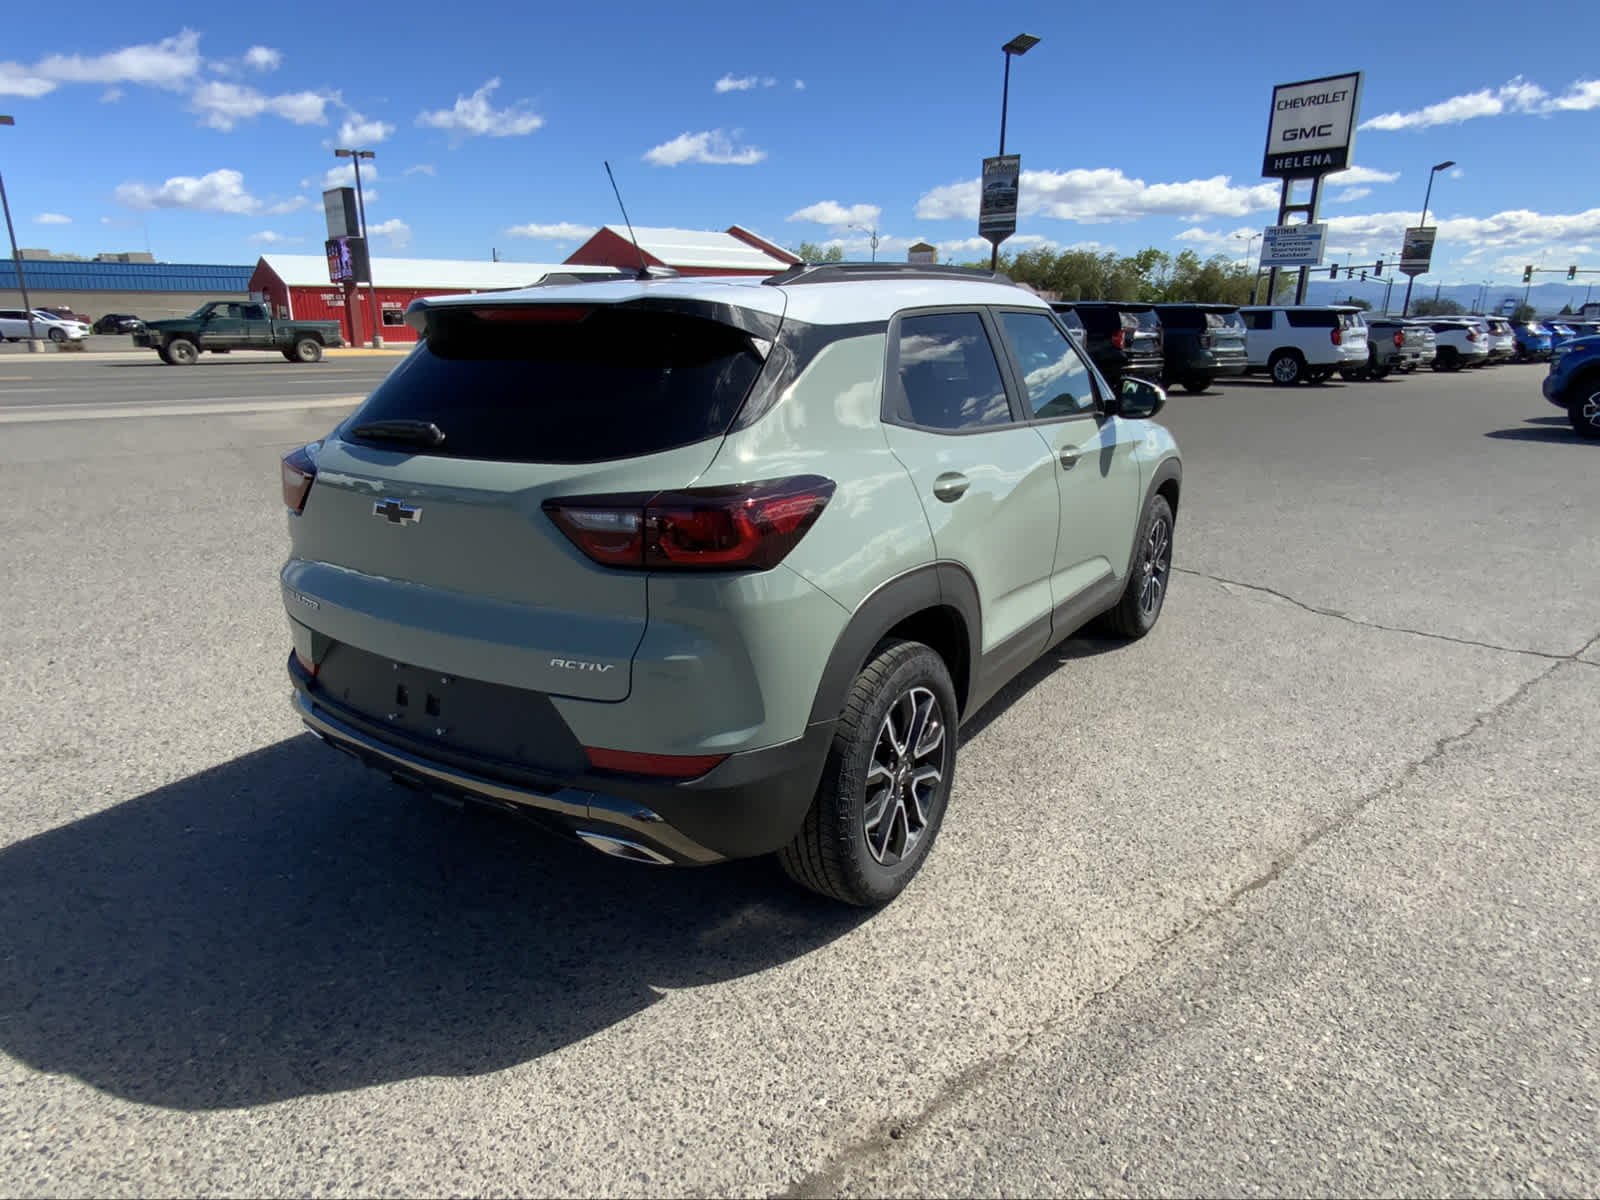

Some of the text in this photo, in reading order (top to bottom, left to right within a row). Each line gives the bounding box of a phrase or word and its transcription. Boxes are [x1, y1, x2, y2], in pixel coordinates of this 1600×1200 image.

[1277, 90, 1348, 111] CHEVROLET
[1282, 124, 1333, 141] GMC
[1274, 153, 1332, 169] HELENA
[550, 658, 615, 672] ACTIV
